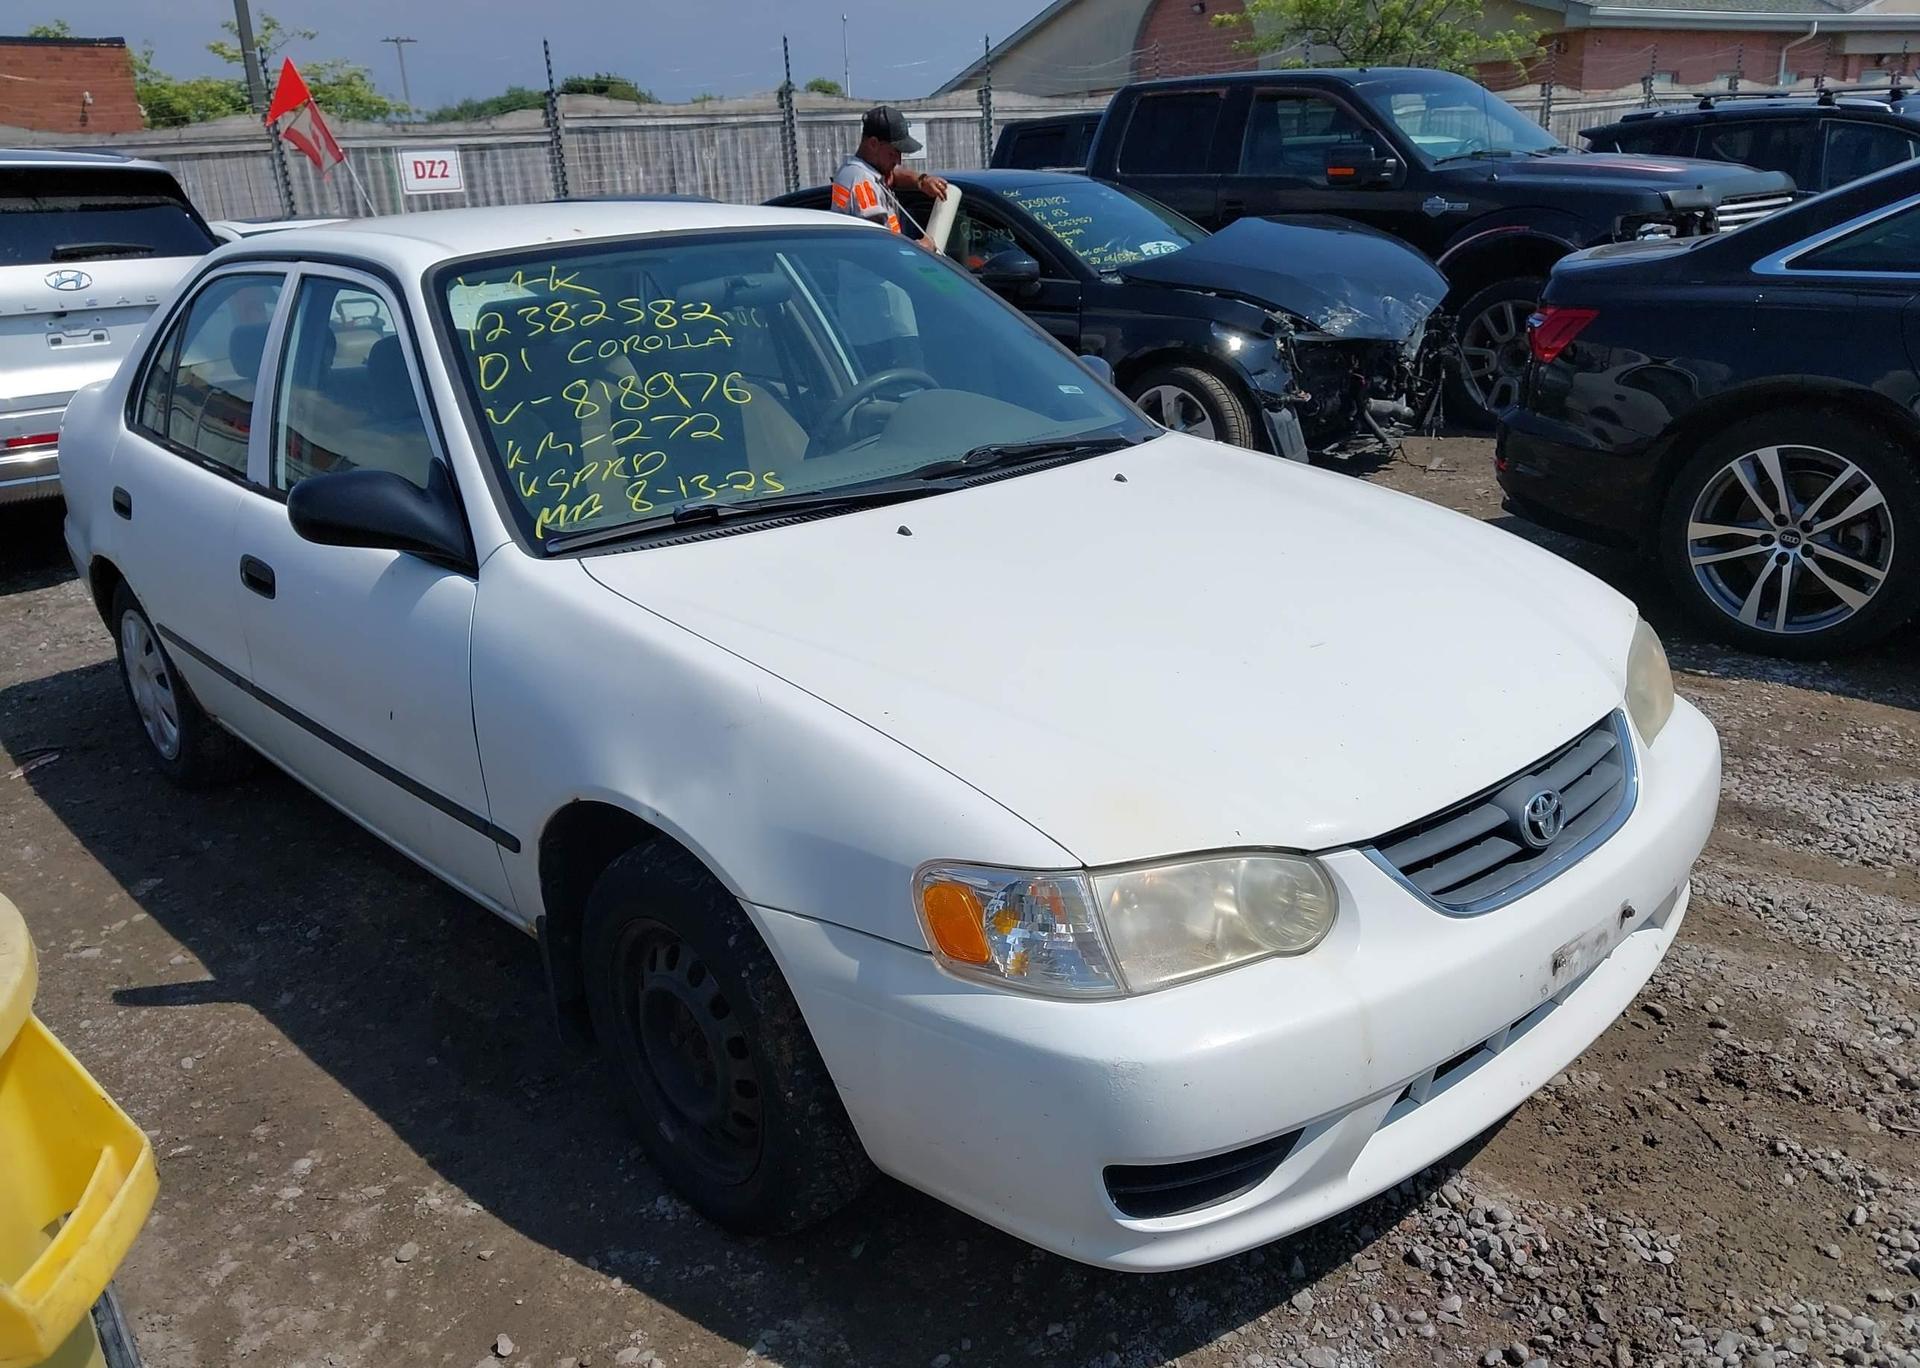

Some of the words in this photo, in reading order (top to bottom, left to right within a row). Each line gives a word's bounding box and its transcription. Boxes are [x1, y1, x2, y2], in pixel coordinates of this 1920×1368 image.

[412, 159, 450, 180] DZ2
[466, 298, 730, 352] 12382582
[567, 327, 735, 365] COROLLA
[625, 470, 786, 513] 8-13-25
